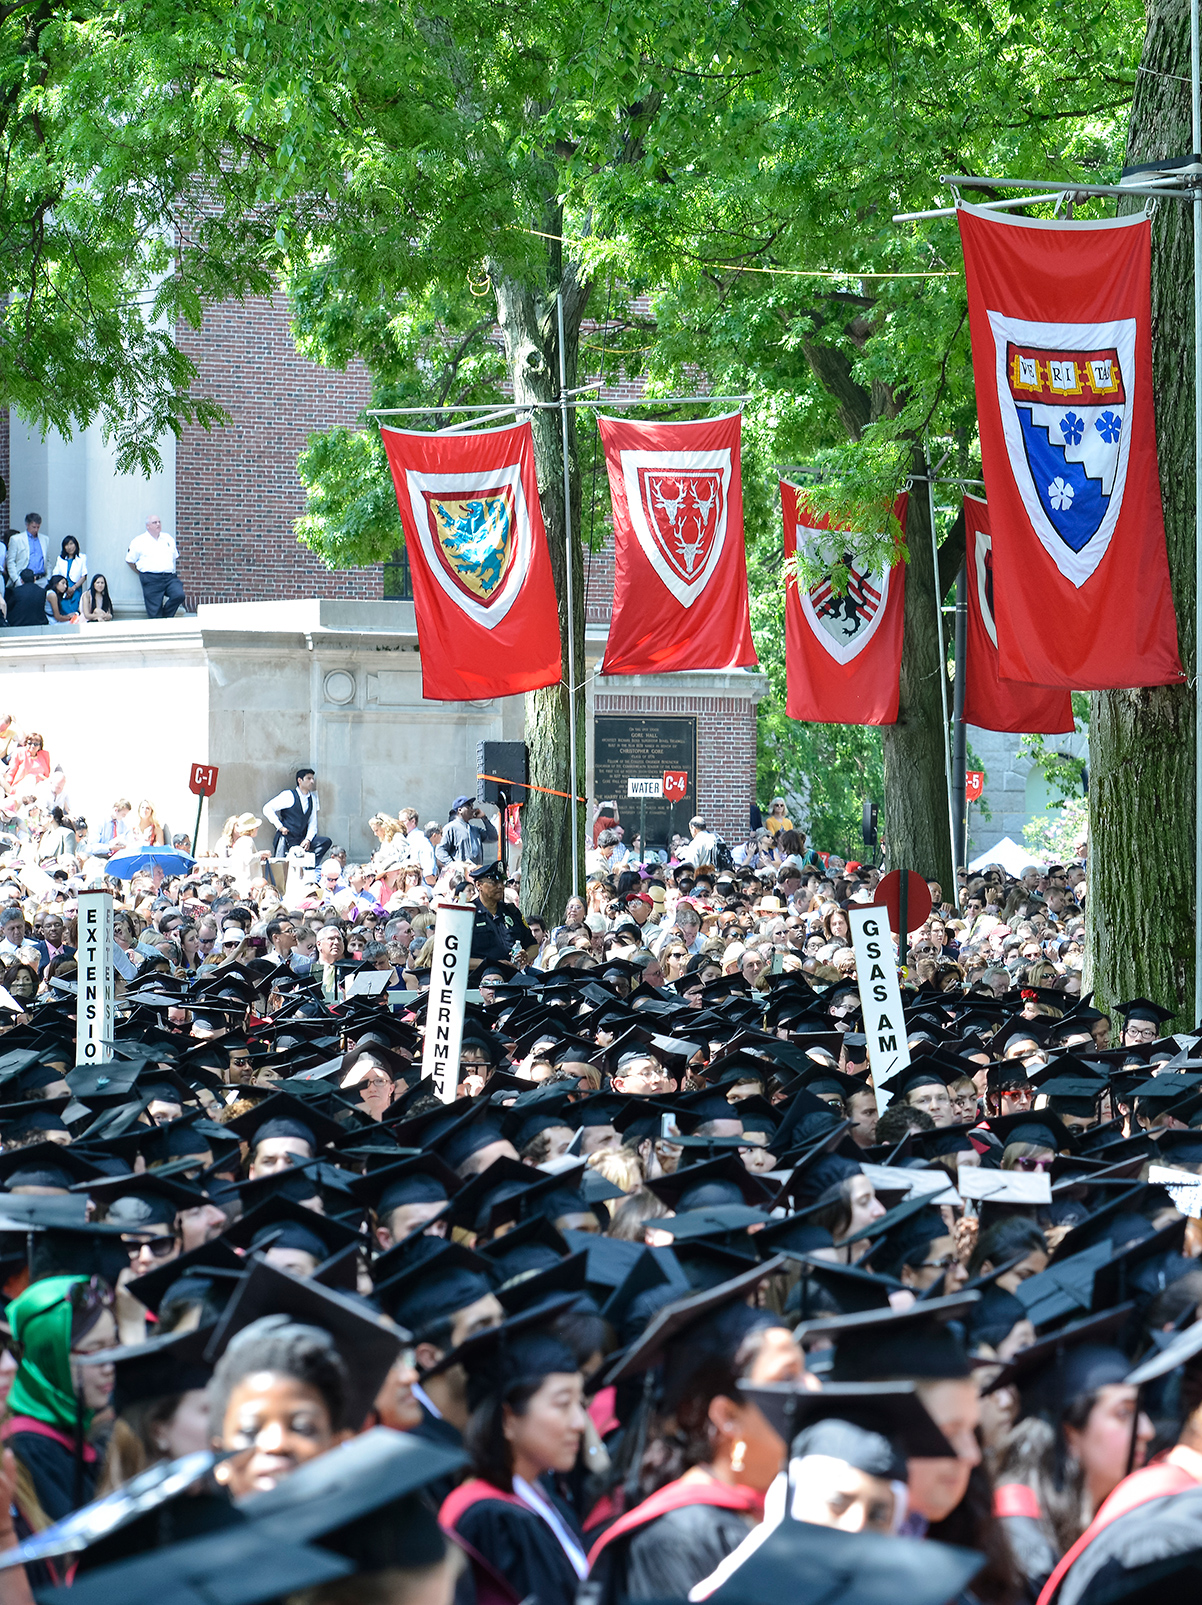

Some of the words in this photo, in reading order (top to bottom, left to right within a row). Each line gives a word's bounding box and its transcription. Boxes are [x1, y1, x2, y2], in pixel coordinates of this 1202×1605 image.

[195, 767, 213, 786] C-1
[631, 782, 660, 793] WATER
[665, 775, 685, 791] C-4
[862, 920, 888, 1002] GSAS
[85, 909, 98, 1066] EXTENSIO
[433, 935, 459, 1095] GOVERNMEN
